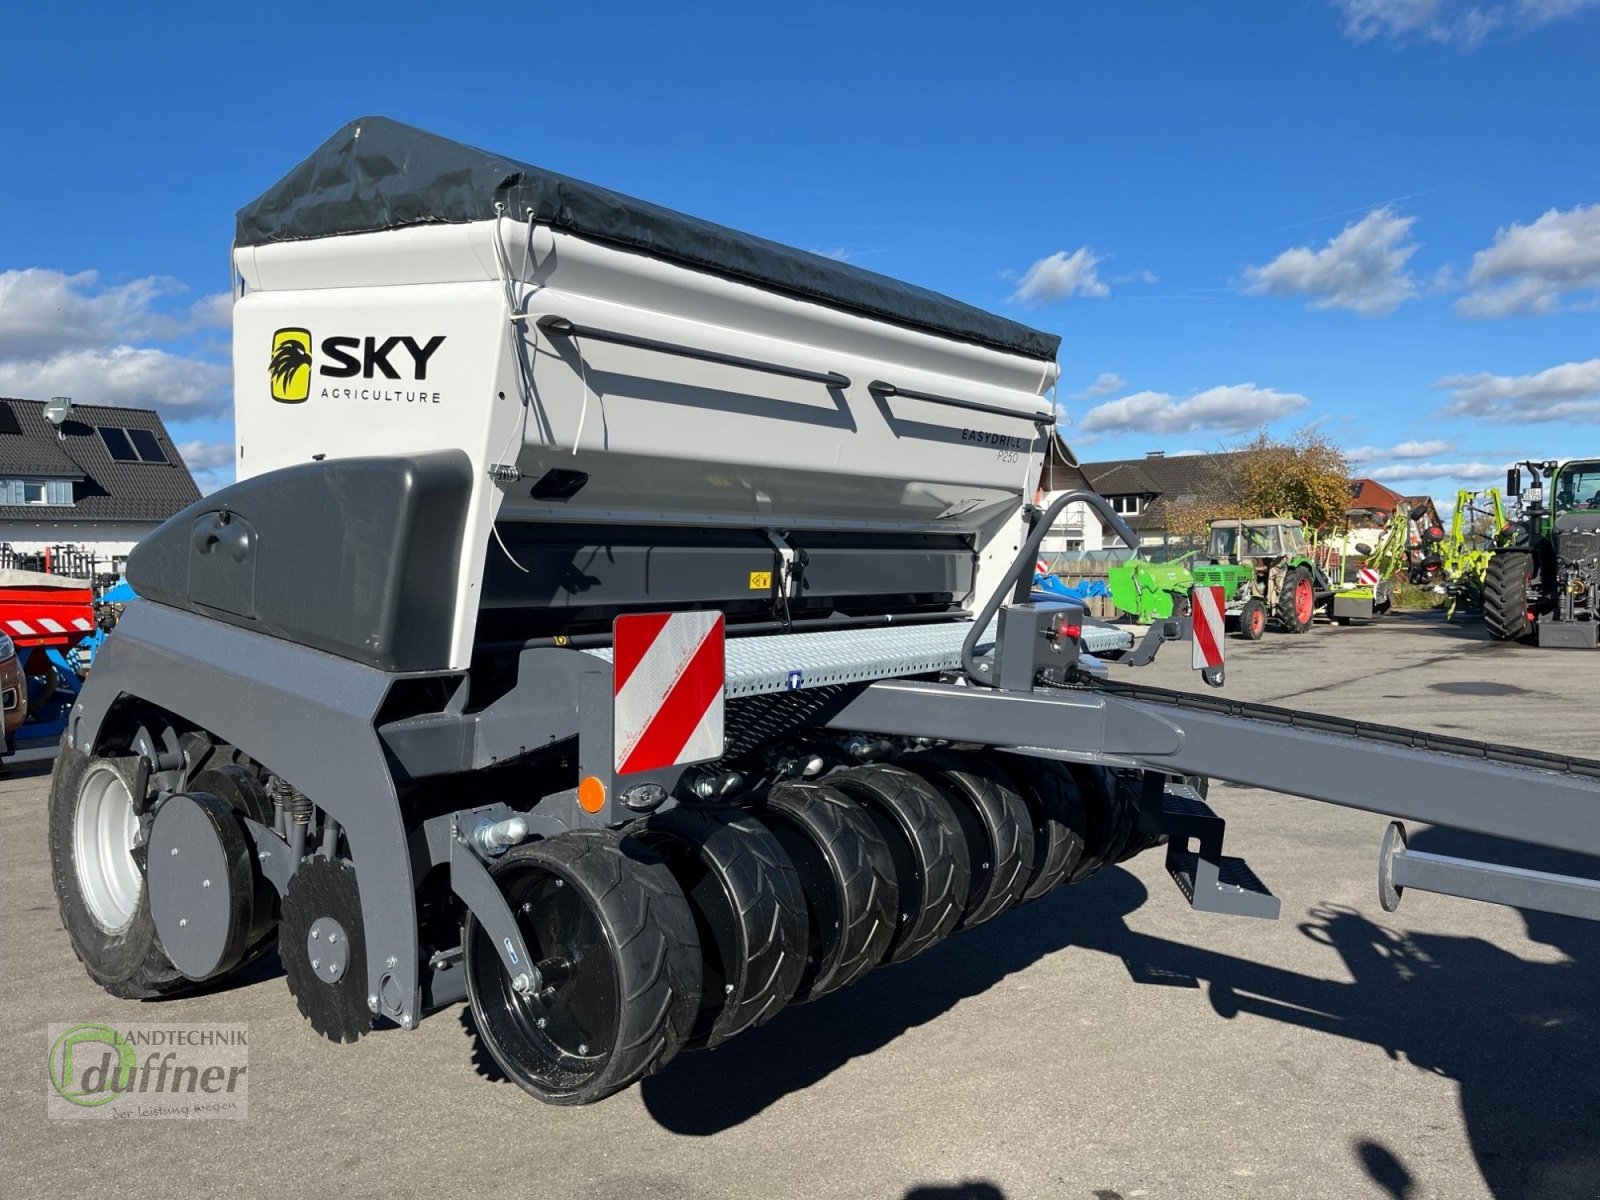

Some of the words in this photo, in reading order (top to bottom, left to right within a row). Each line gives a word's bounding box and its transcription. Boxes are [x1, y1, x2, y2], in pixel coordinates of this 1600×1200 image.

[320, 336, 447, 380] SKY
[321, 388, 441, 403] AGRICULTURE
[961, 429, 1021, 448] EASYDRILL
[998, 451, 1019, 463] P250
